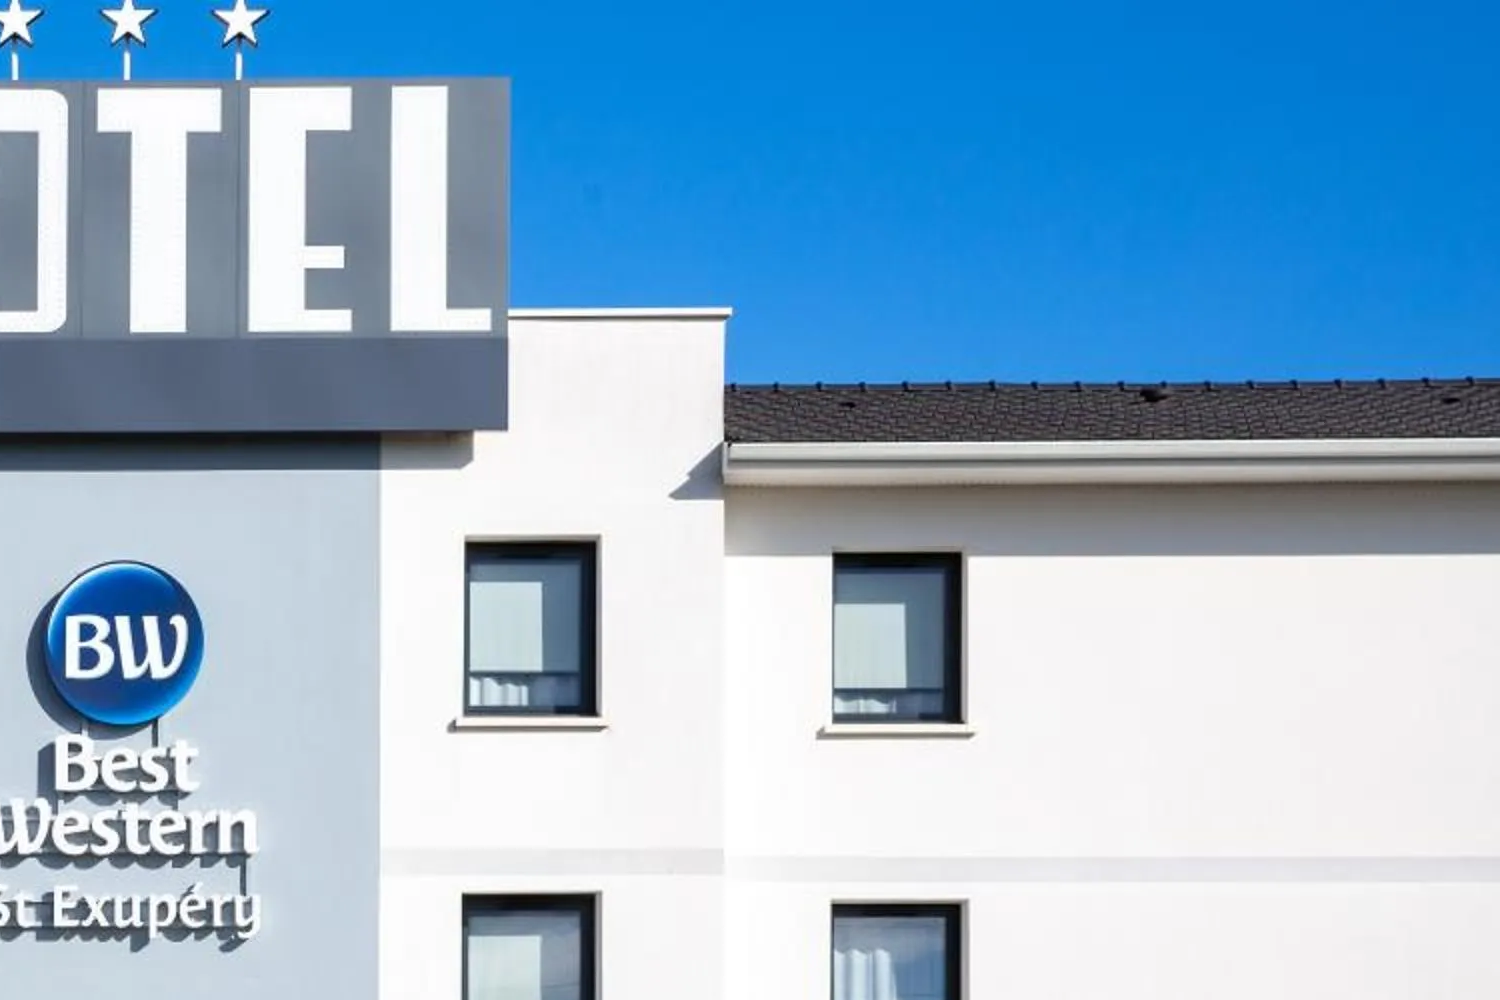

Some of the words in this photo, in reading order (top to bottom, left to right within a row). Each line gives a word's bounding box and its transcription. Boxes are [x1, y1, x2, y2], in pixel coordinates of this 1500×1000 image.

[65, 614, 190, 680] BW
[54, 733, 201, 793] Best
[53, 881, 262, 939] Exupéry
